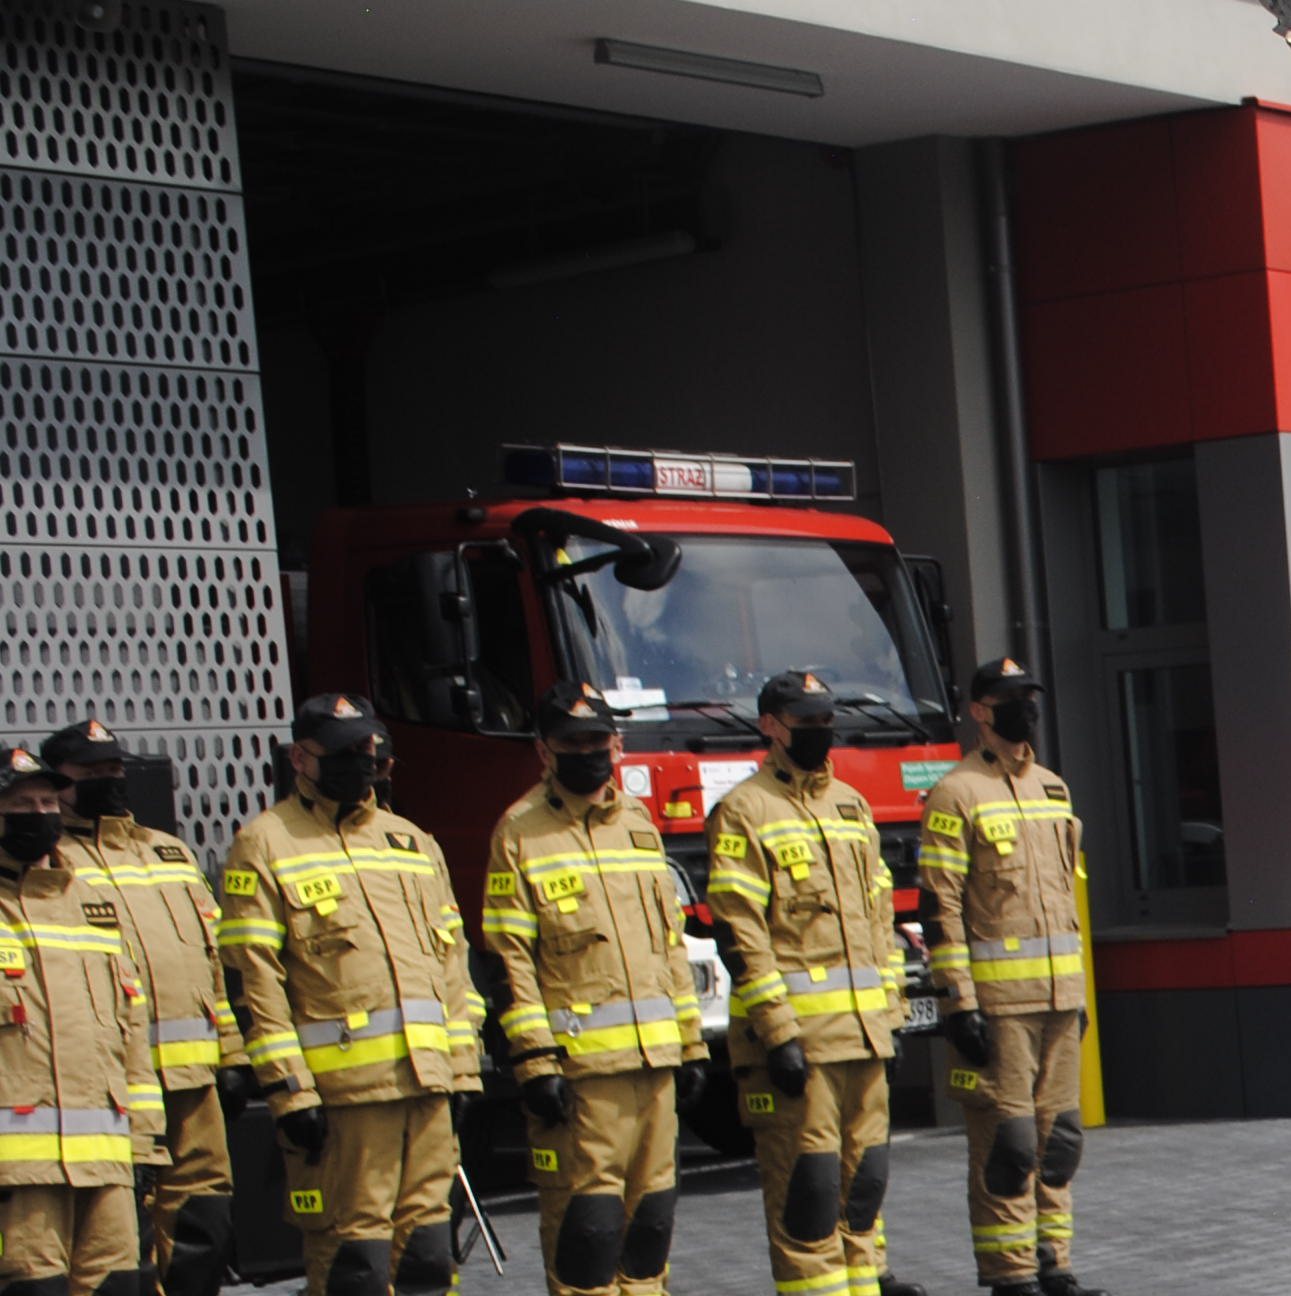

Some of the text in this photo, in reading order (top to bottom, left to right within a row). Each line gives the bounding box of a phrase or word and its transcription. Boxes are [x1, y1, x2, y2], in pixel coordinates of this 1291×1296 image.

[933, 816, 956, 830] PSP
[717, 838, 741, 852] SP
[227, 876, 250, 890] PSP
[303, 879, 332, 898] PSP
[491, 878, 510, 889] PSP
[549, 876, 576, 894] PSP
[0, 950, 17, 964] SP
[911, 999, 934, 1021] 98
